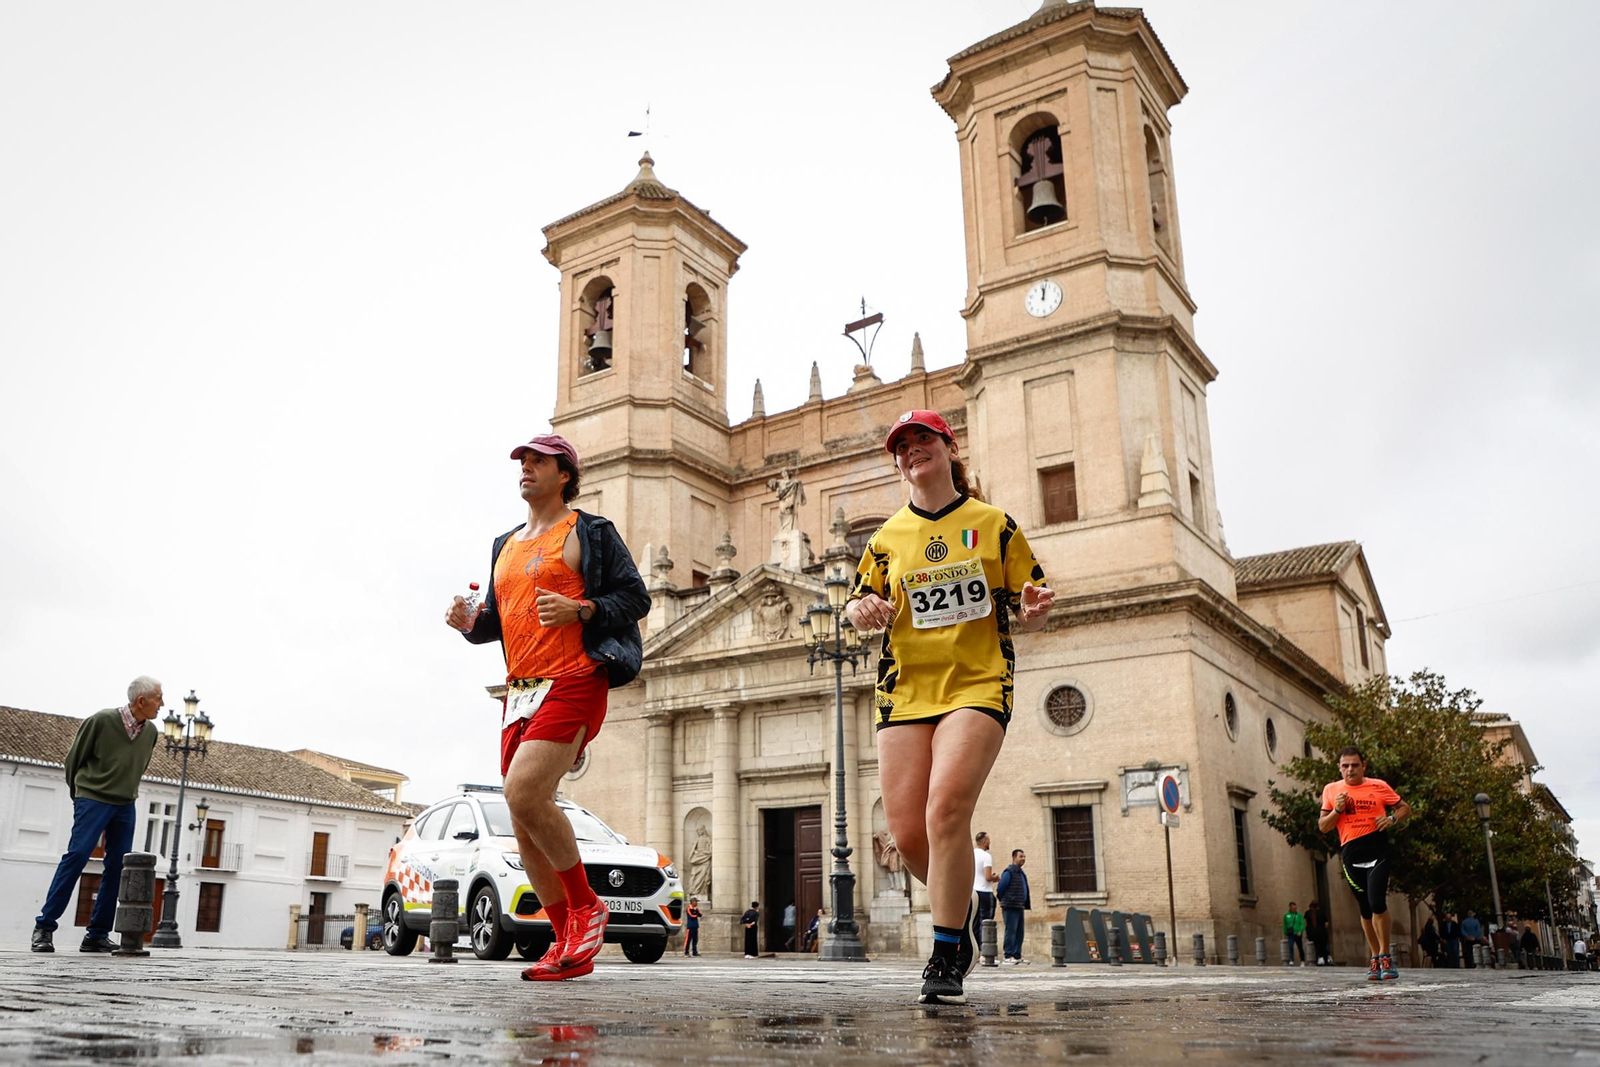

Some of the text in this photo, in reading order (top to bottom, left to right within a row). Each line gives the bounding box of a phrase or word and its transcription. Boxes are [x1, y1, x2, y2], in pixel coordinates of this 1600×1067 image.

[915, 572, 929, 584] 38
[928, 567, 968, 582] FONDO
[911, 580, 986, 614] 3219
[608, 869, 625, 888] MG
[624, 901, 643, 912] NDS
